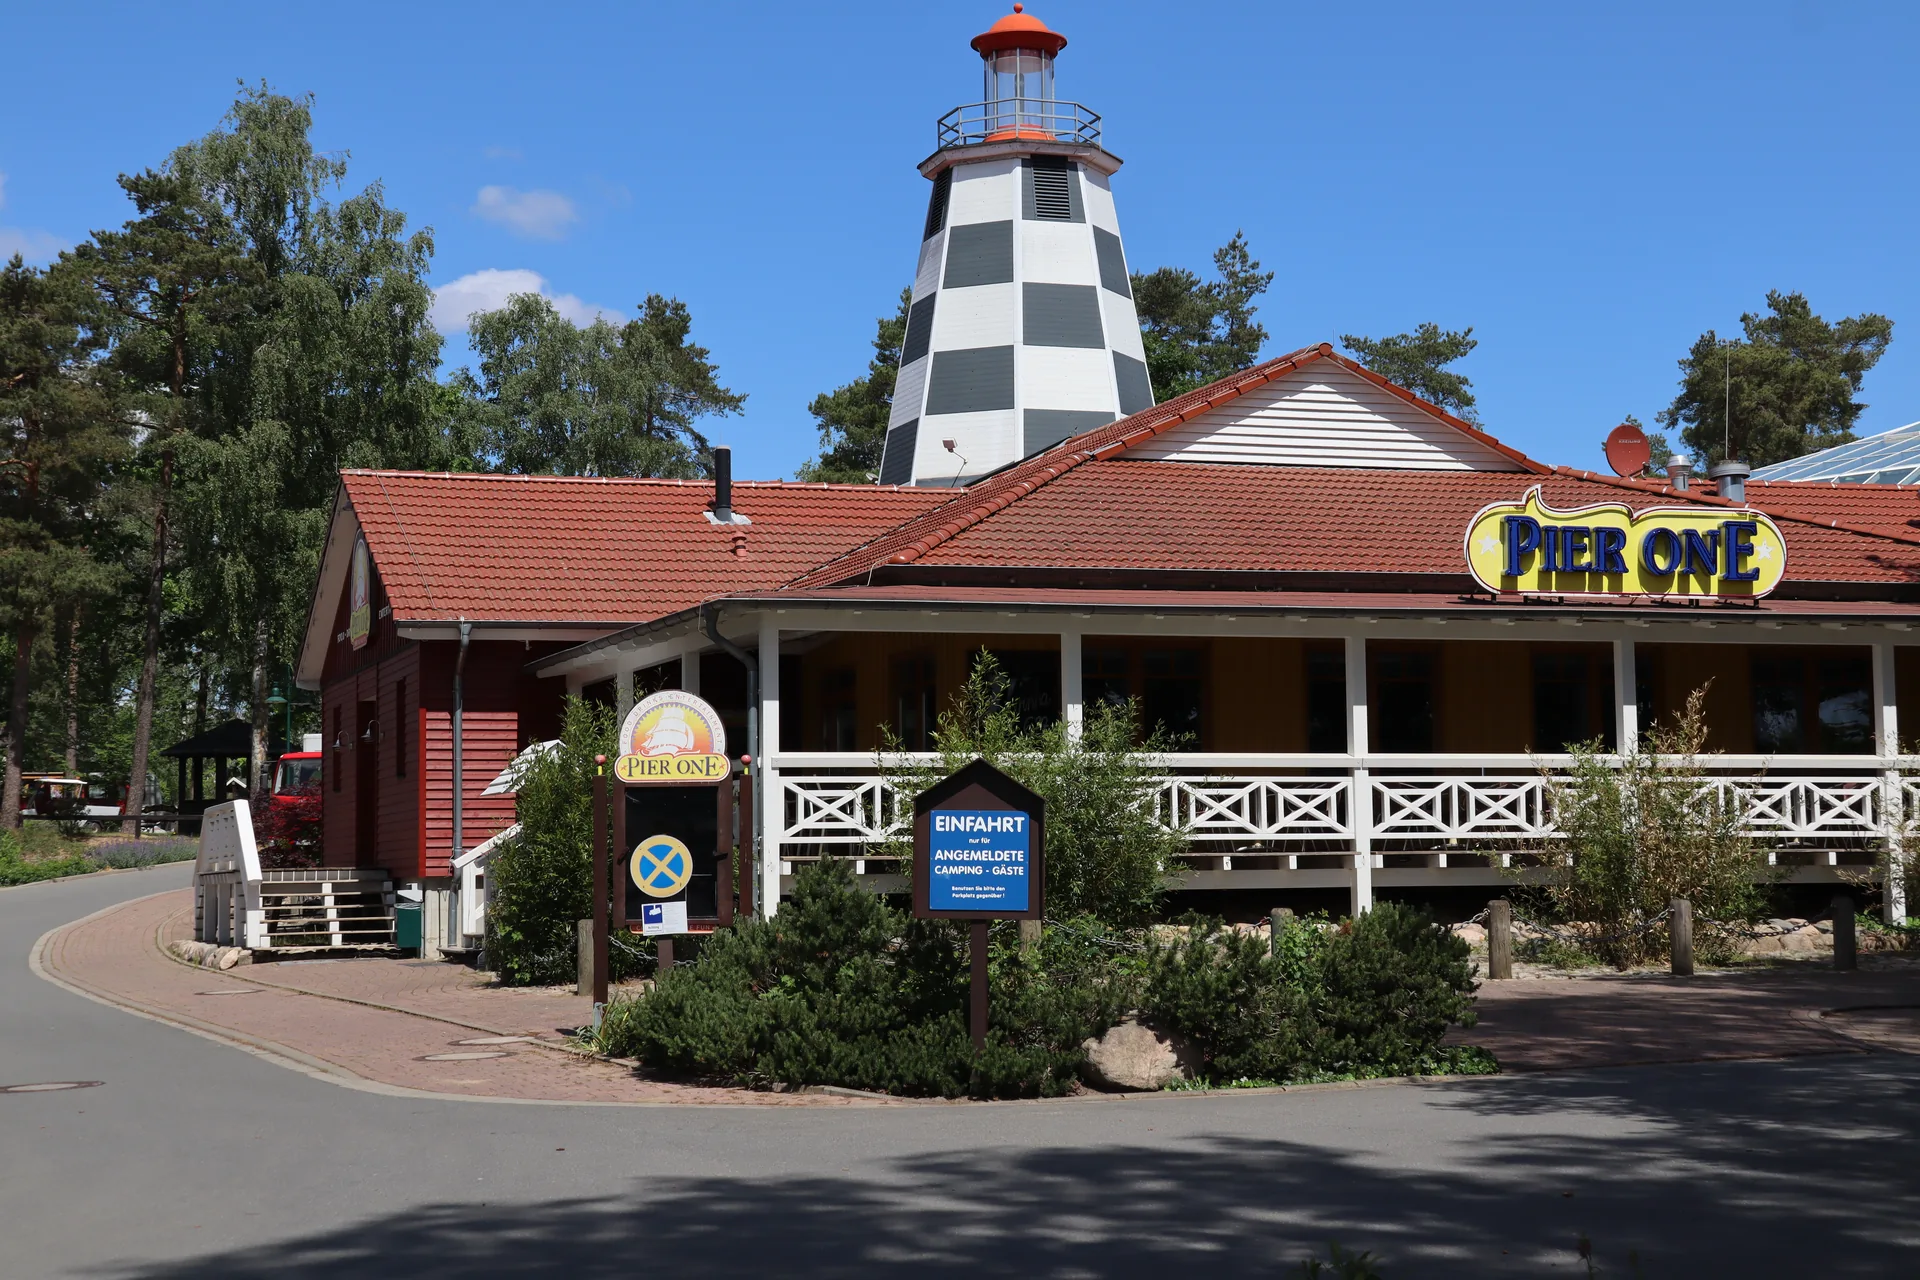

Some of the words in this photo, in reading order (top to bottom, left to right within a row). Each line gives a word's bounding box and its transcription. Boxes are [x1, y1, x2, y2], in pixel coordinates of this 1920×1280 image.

[1502, 516, 1629, 576] PIER
[1639, 520, 1761, 581] ONE
[623, 721, 633, 745] FOOD
[633, 695, 664, 717] DRINKS
[669, 694, 723, 744] ENTERTAINMENT
[627, 757, 671, 777] PIER
[677, 756, 720, 777] ONE
[935, 816, 1025, 832] EINFAHRT
[934, 850, 1024, 861] ANGEMELDETE
[934, 865, 983, 875] CAMPING
[992, 864, 1024, 876] GÄSTE
